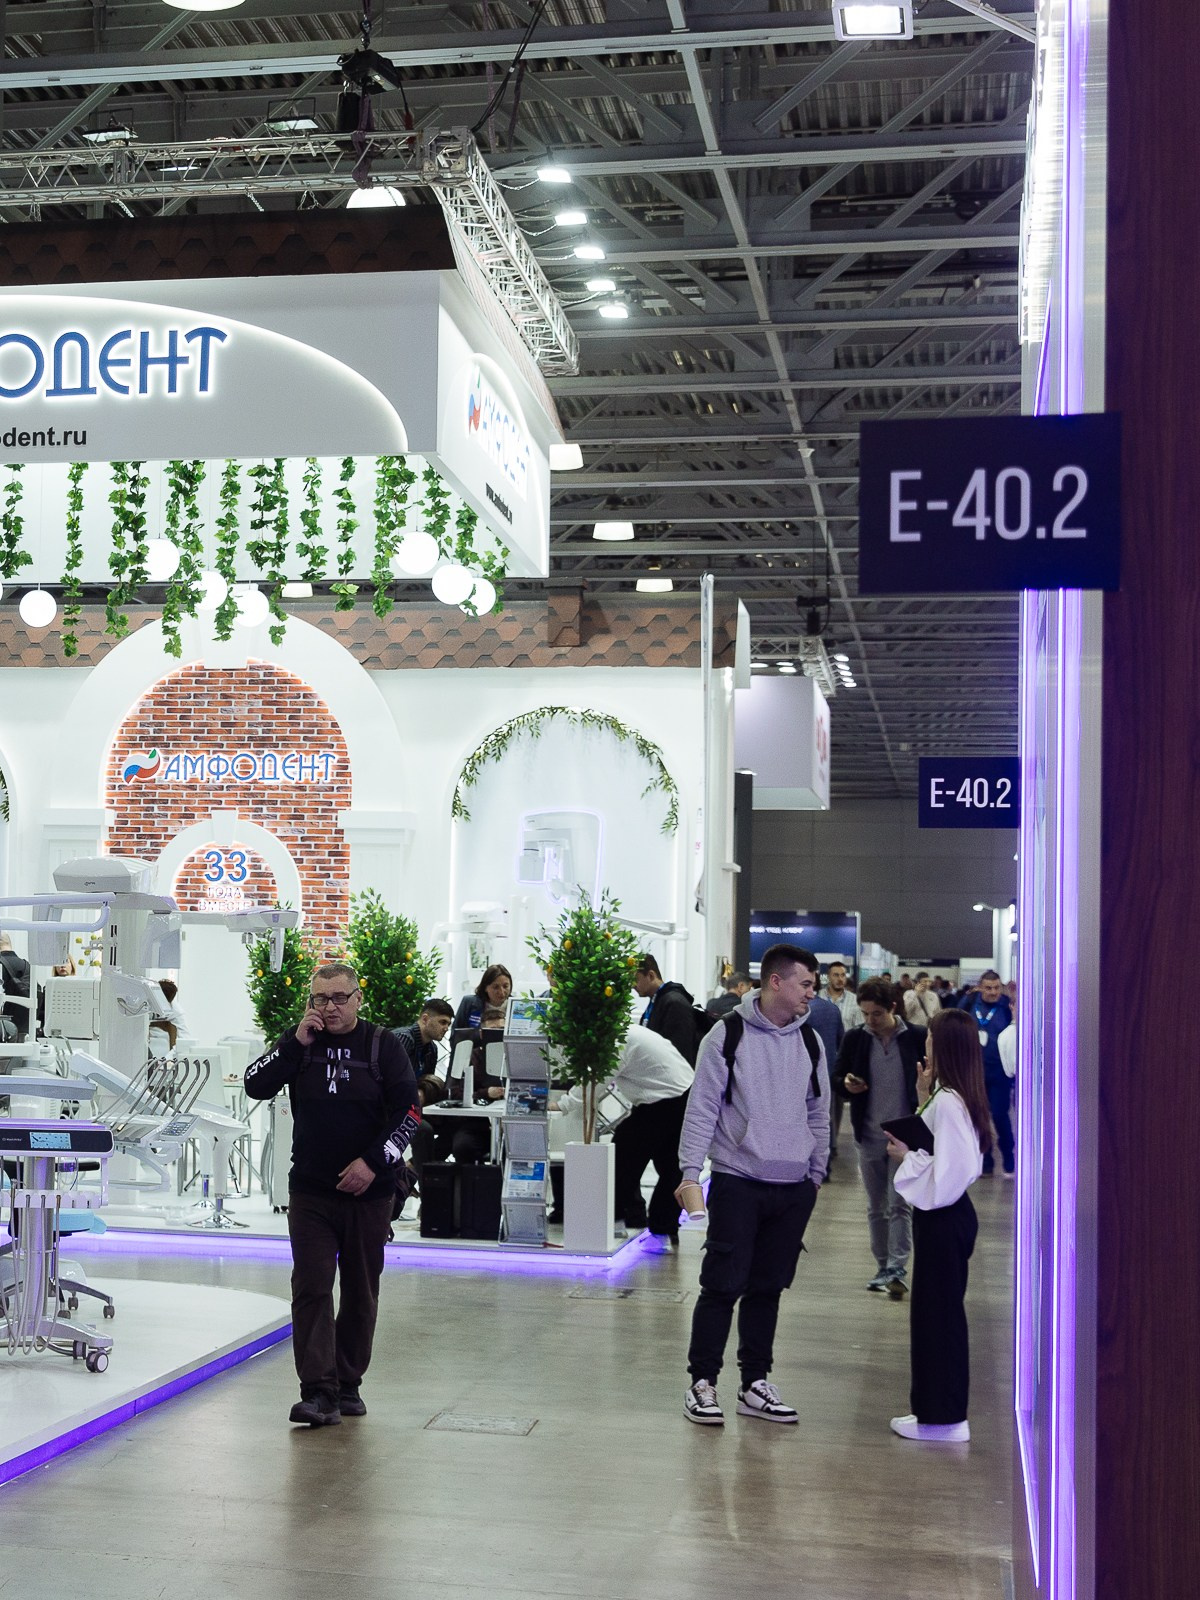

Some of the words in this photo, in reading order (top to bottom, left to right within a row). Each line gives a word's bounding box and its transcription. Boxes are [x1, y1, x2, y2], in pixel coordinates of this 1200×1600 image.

[890, 465, 1088, 542] E-40.2
[164, 753, 336, 782] АМФОДЕНТ
[930, 777, 1012, 808] E-40.2
[204, 850, 247, 882] 33
[198, 901, 251, 911] ВМЕСТЕ
[208, 887, 242, 899] ГОДА
